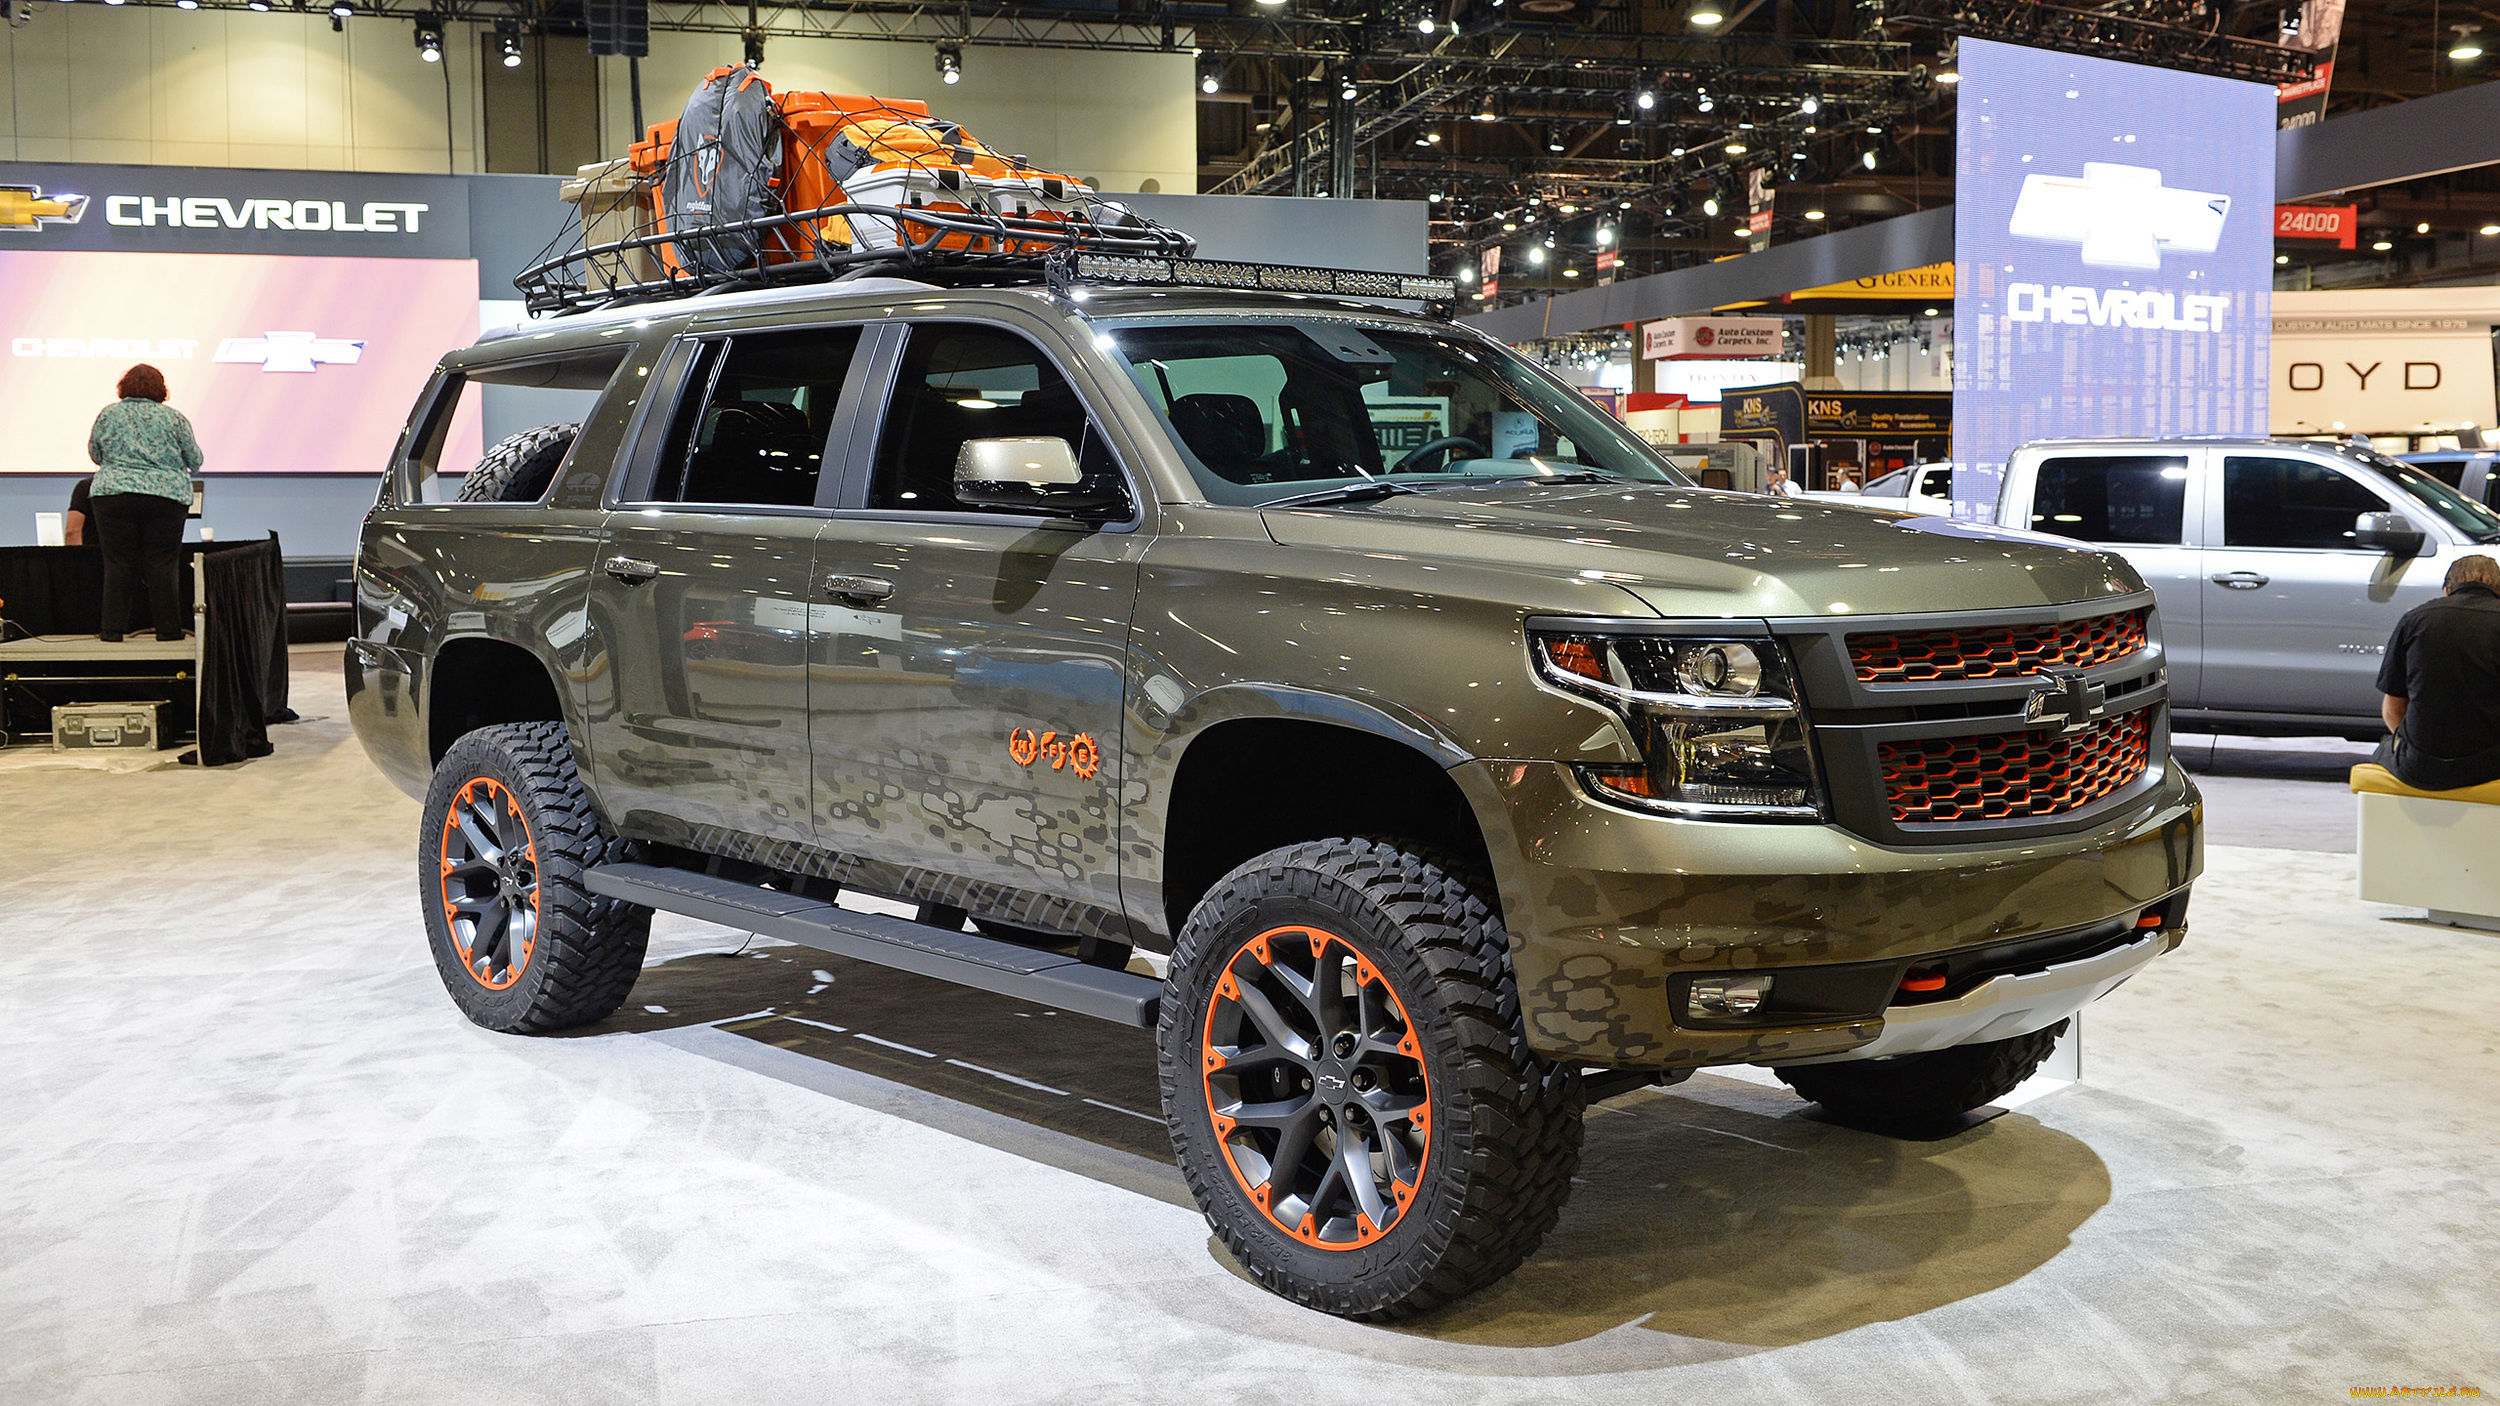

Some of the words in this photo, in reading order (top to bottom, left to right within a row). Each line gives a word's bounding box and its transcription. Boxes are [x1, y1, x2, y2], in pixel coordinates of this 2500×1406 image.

[105, 194, 429, 234] CHEVROLET
[2279, 212, 2340, 233] 24000
[2007, 282, 2231, 333] CHEVROLET
[1718, 328, 1740, 336] Auto
[1740, 328, 1774, 336] Custom
[2275, 321, 2323, 331] CUSTOM
[2325, 321, 2357, 330] AUTO
[2359, 320, 2394, 330] MATS
[2396, 320, 2432, 329] SINCE
[11, 337, 200, 360] CHEVROLET
[1743, 397, 1762, 414] KNS
[1808, 399, 1842, 415] KNS
